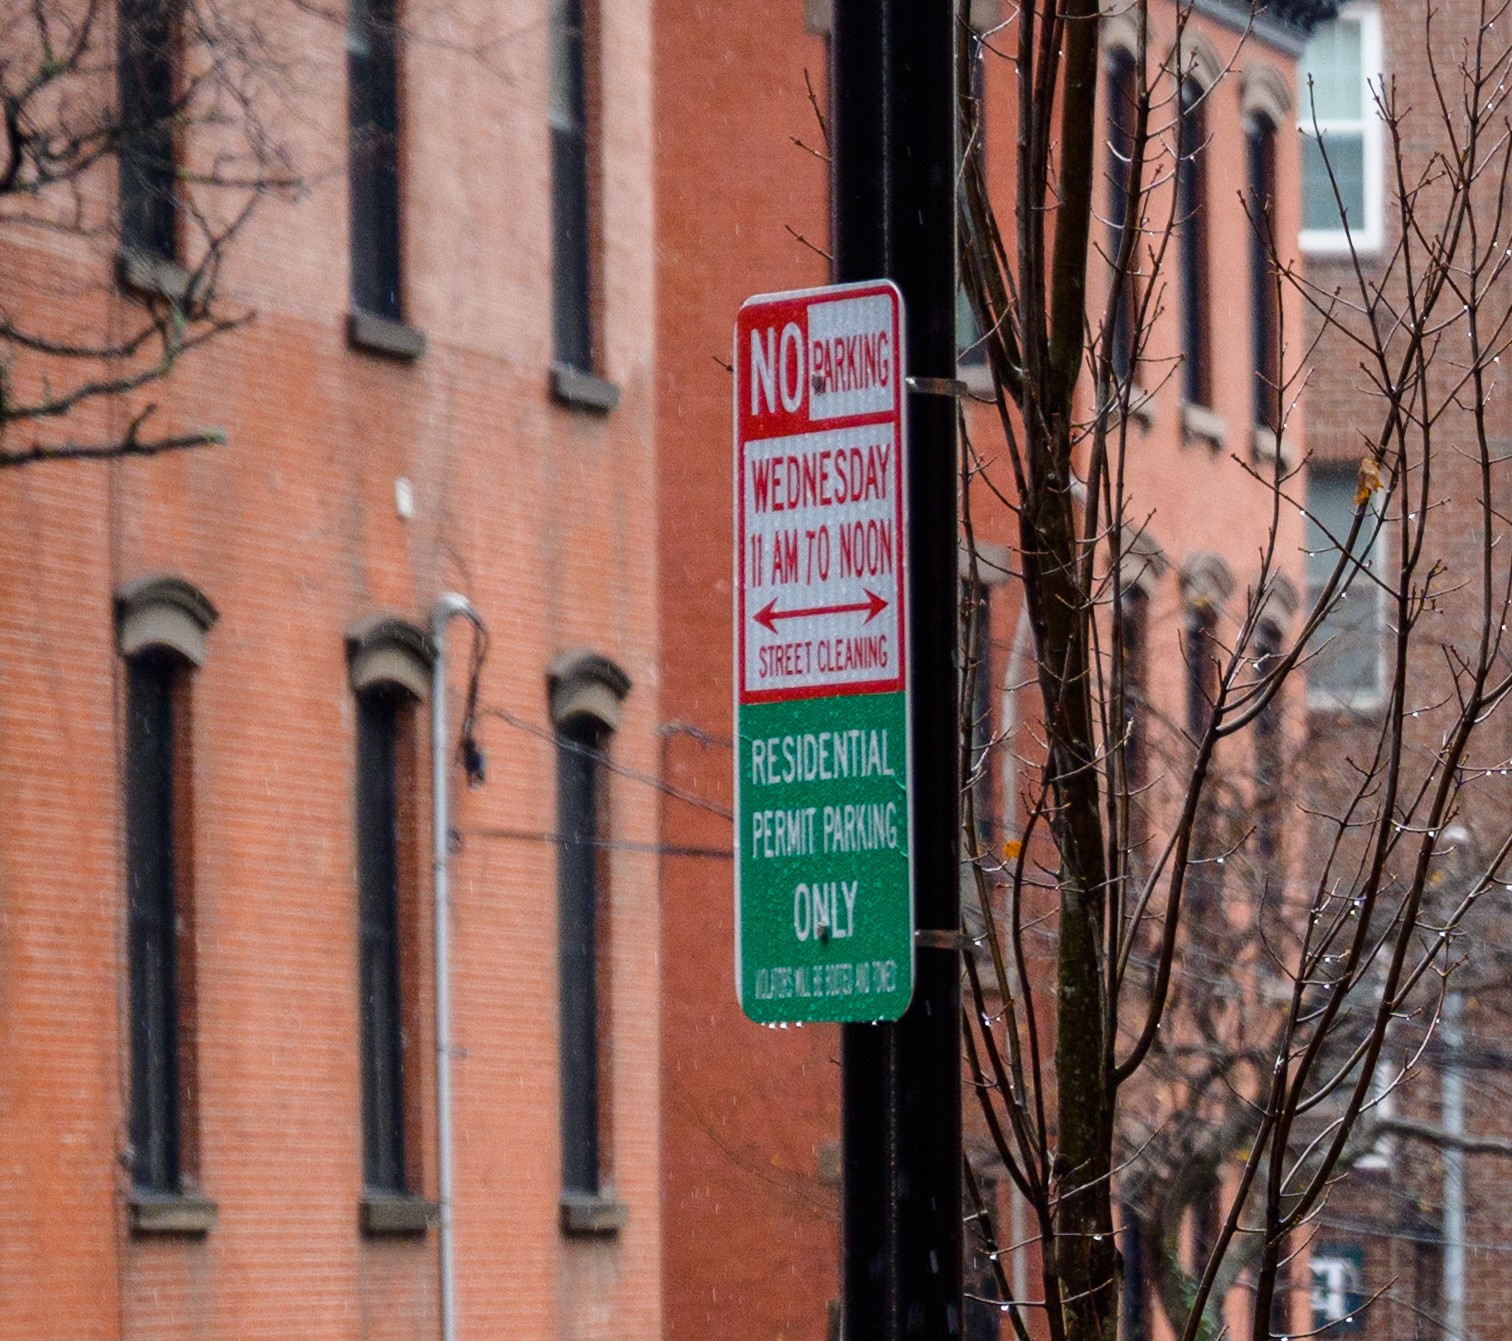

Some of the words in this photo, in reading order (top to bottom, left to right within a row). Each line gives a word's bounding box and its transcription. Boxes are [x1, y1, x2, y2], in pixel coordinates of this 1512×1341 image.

[751, 322, 803, 416] NO
[812, 331, 890, 394] PARKING
[751, 444, 892, 513] WEDNESDAY
[751, 533, 762, 587] 11
[772, 529, 798, 585] AM
[805, 524, 829, 586] TO
[839, 519, 892, 580] NOON
[758, 640, 812, 679] STREET
[817, 634, 888, 673] CLEANING
[752, 729, 895, 785] RESIDENTIAL
[752, 807, 816, 858] PERMIT
[823, 801, 898, 854] PARKING
[793, 880, 858, 942] ONLY
